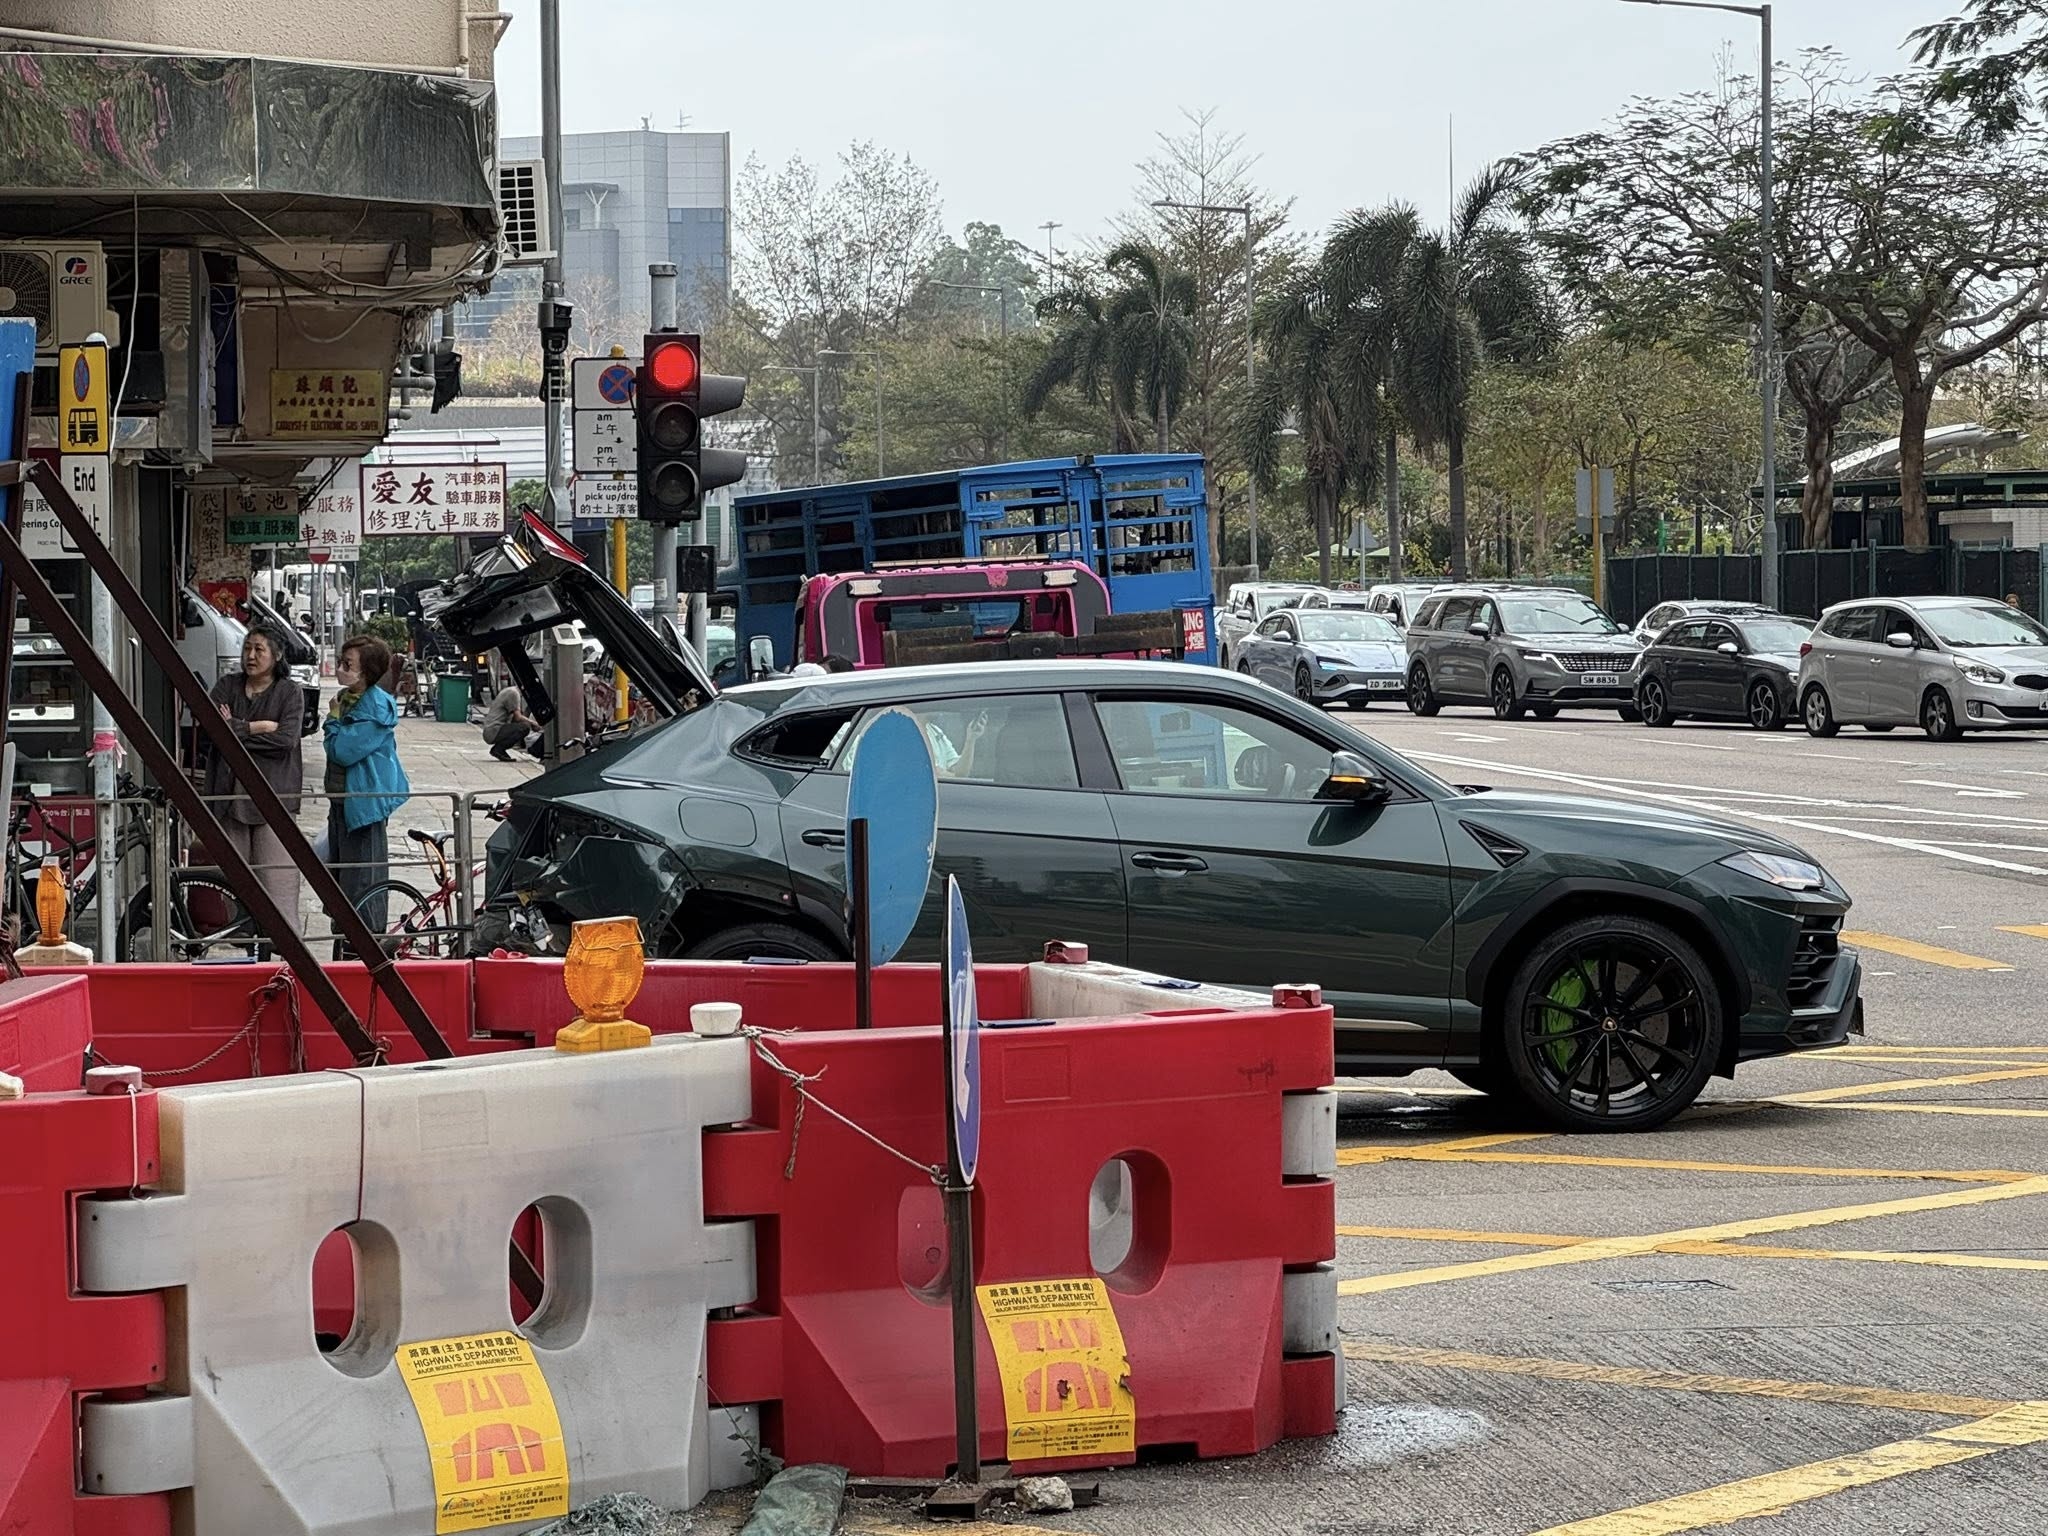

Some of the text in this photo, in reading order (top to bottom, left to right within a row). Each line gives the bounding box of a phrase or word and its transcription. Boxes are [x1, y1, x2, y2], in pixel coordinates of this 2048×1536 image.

[60, 276, 93, 285] GREE
[596, 413, 613, 421] am
[592, 423, 618, 435] 上午
[597, 446, 613, 455] pm
[592, 456, 618, 467] 下午
[73, 466, 96, 492] End
[444, 471, 501, 487] 汽車換油
[370, 470, 440, 506] 愛友
[596, 483, 627, 492] Except
[235, 490, 289, 513] 電池
[445, 490, 502, 505] 驗車服務
[585, 493, 603, 501] pick
[580, 504, 638, 515] 的士上落客
[229, 519, 297, 536] 驗車服務
[367, 508, 501, 532] 修理汽車服務
[1182, 611, 1205, 632] ING
[1184, 632, 1206, 651] 煙
[992, 1292, 1096, 1307] HIGHWAYS DEPARTMENT
[413, 1346, 520, 1369] HIGHWAYS DEPARTMENT
[416, 1366, 434, 1375] MAJOR
[435, 1363, 454, 1372] WORKS
[454, 1360, 475, 1369] PROJECT
